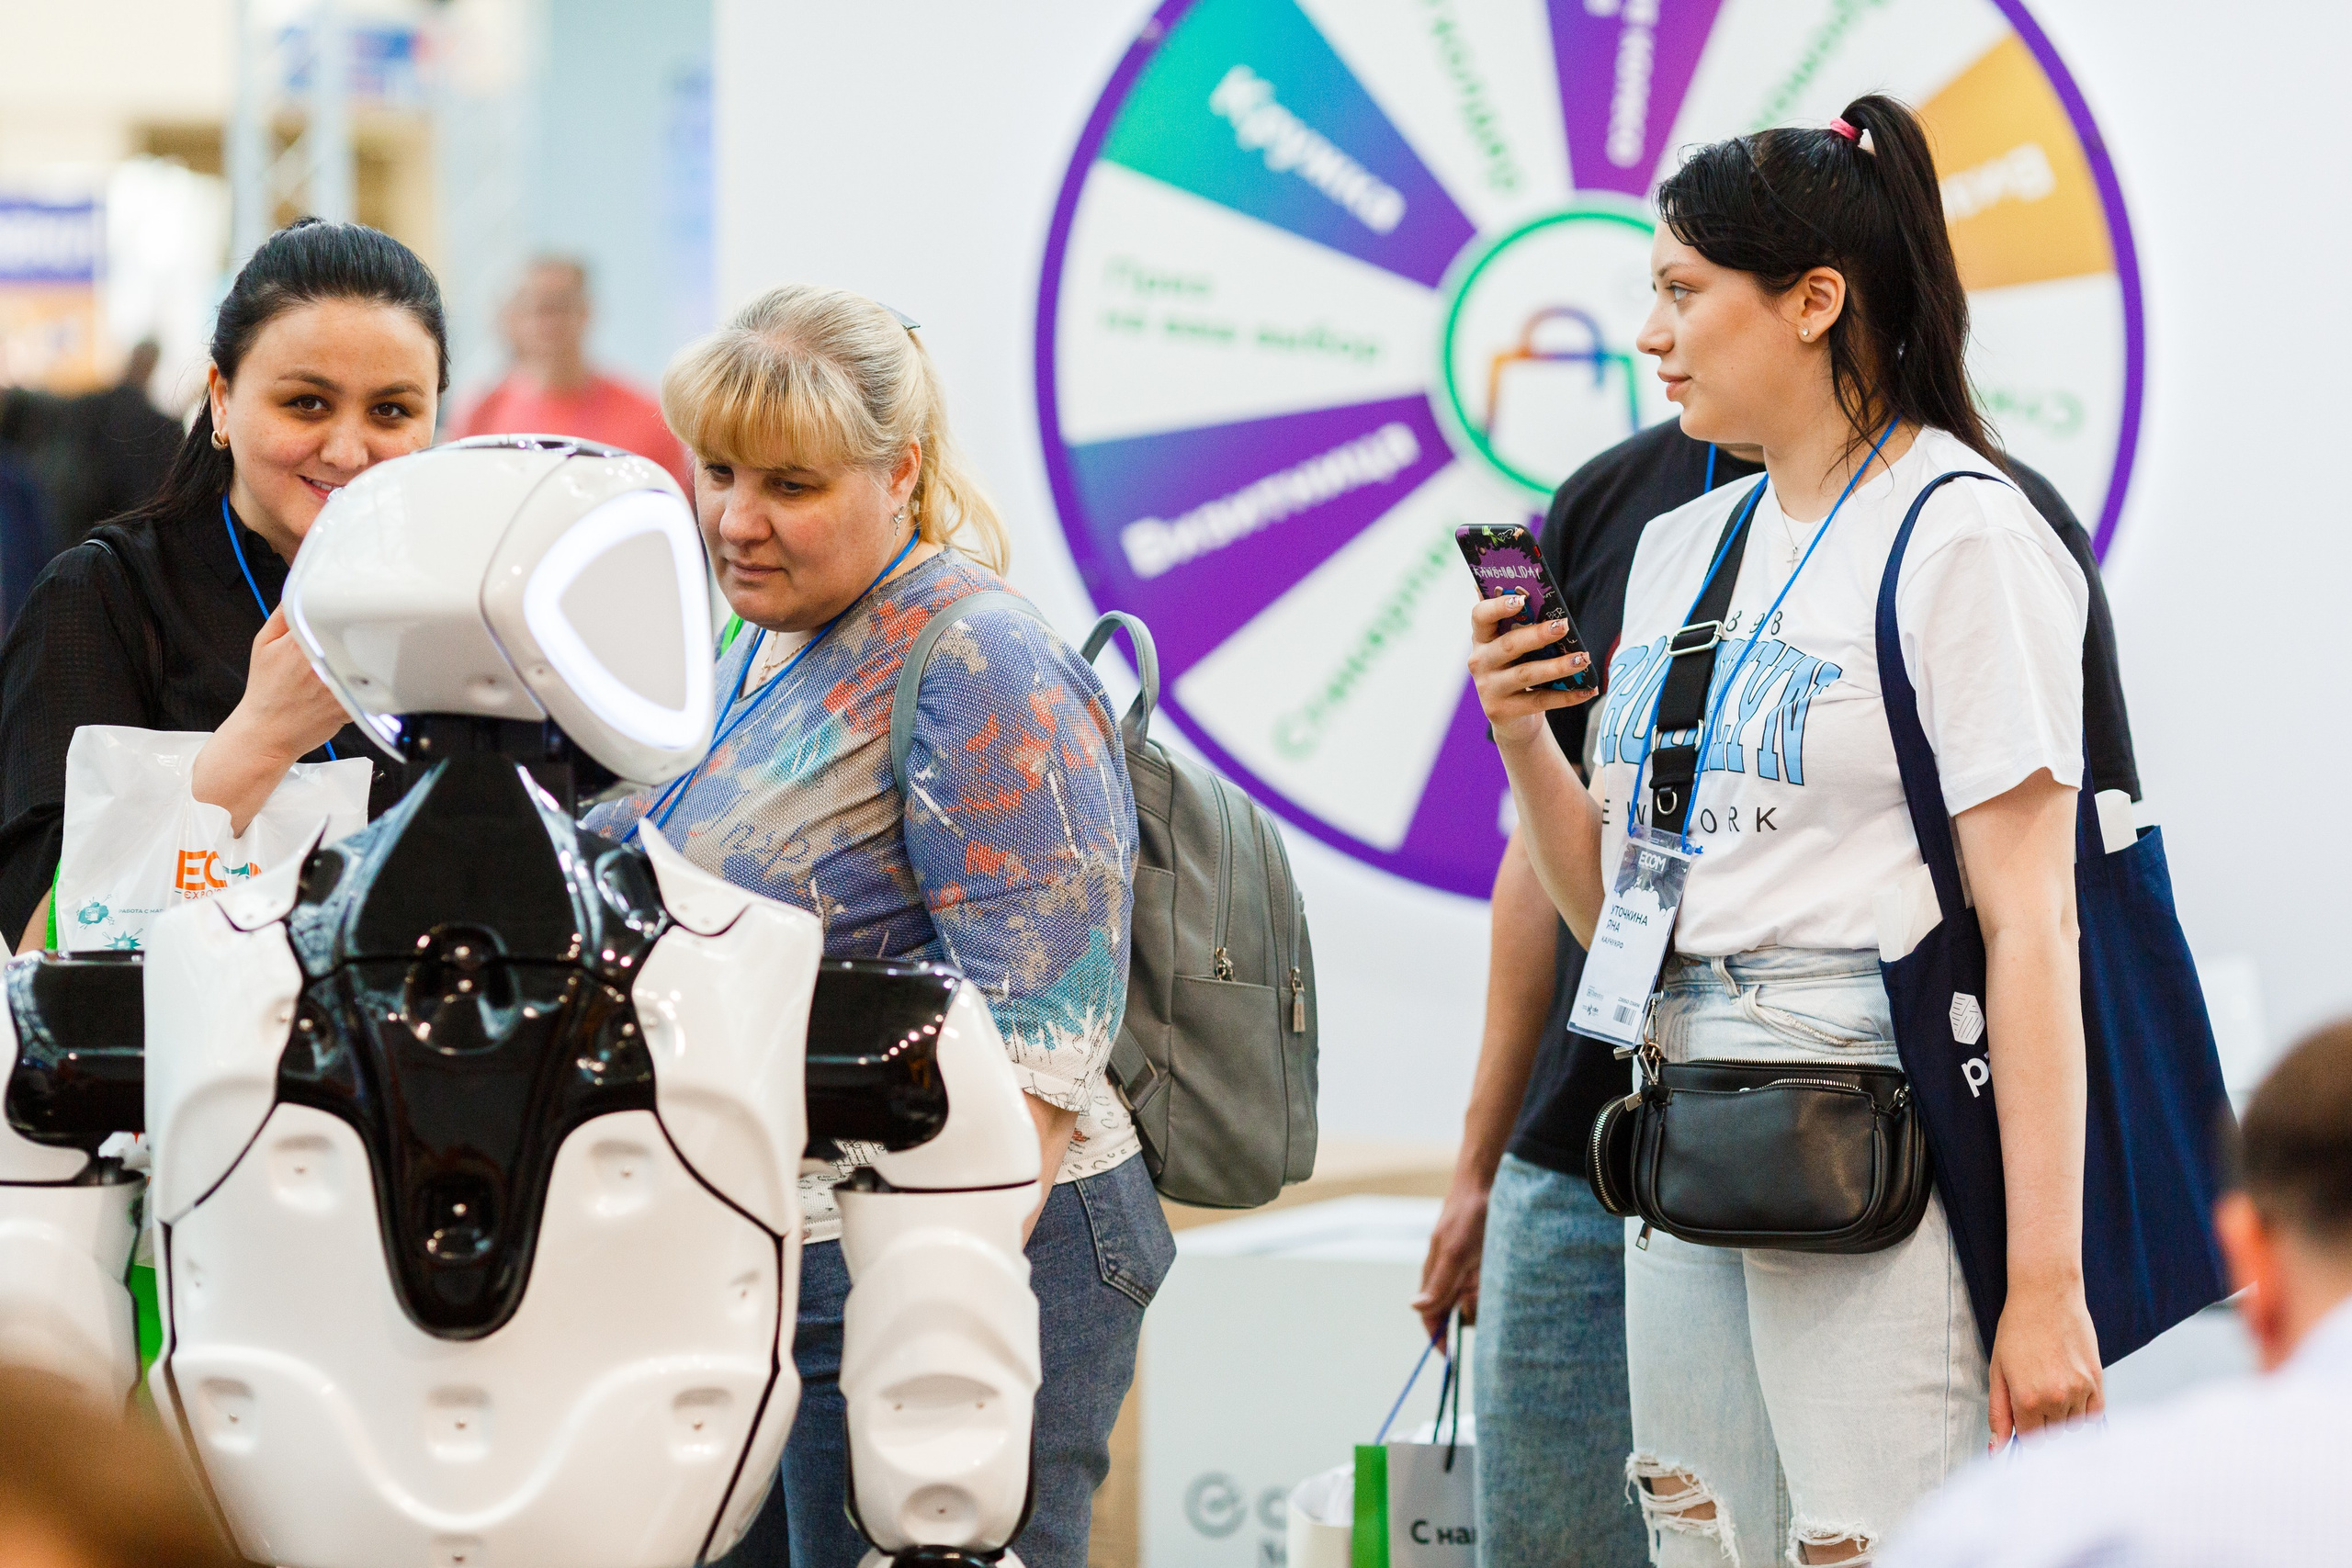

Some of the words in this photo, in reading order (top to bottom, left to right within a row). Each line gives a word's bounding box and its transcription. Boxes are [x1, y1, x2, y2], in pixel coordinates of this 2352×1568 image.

[1725, 610, 1784, 636] 898
[1700, 806, 1778, 833] ORK
[1638, 851, 1667, 873] ECOM
[1606, 919, 1621, 933] ЯНА
[1611, 904, 1648, 927] УТОЧКИНА
[1409, 1517, 1430, 1545] С
